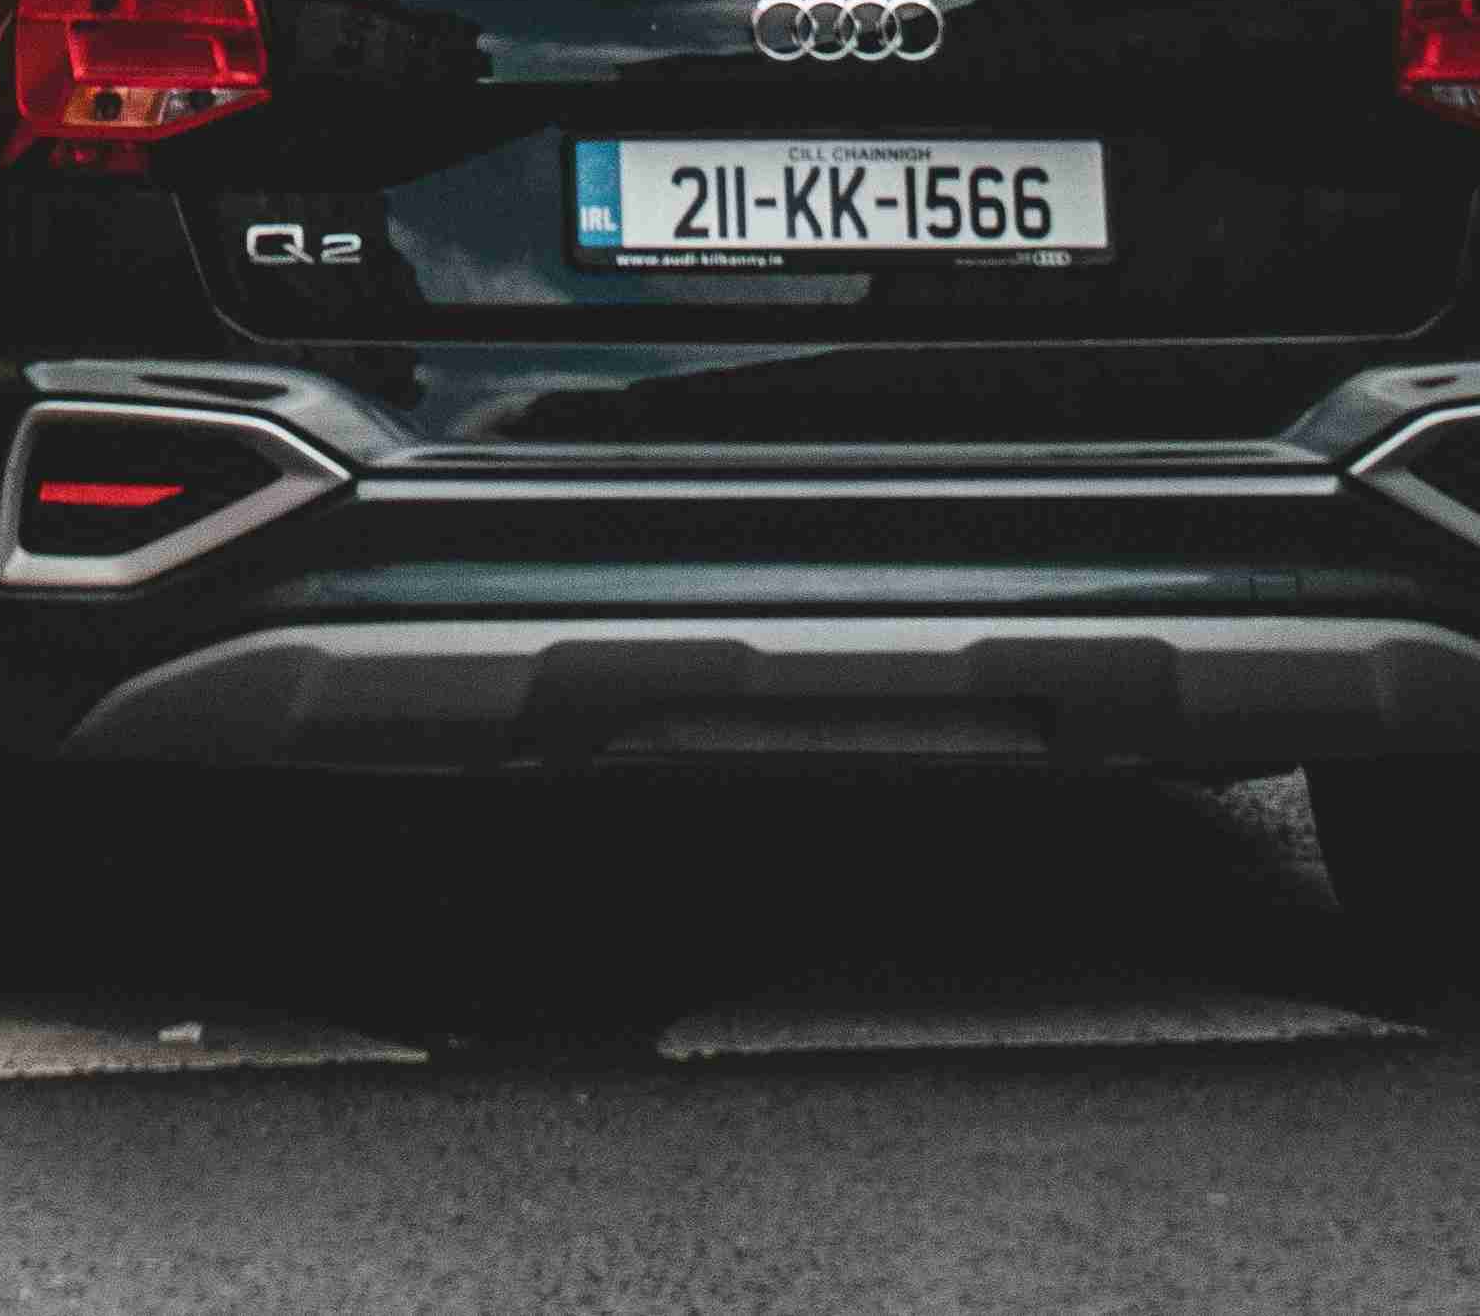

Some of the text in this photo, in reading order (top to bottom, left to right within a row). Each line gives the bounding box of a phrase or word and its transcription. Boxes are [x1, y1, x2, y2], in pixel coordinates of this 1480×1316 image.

[788, 146, 933, 163] CILL CHAINNIGH
[579, 205, 618, 232] IRL
[671, 165, 1052, 240] 211-KK-1566
[245, 223, 362, 264] Q2
